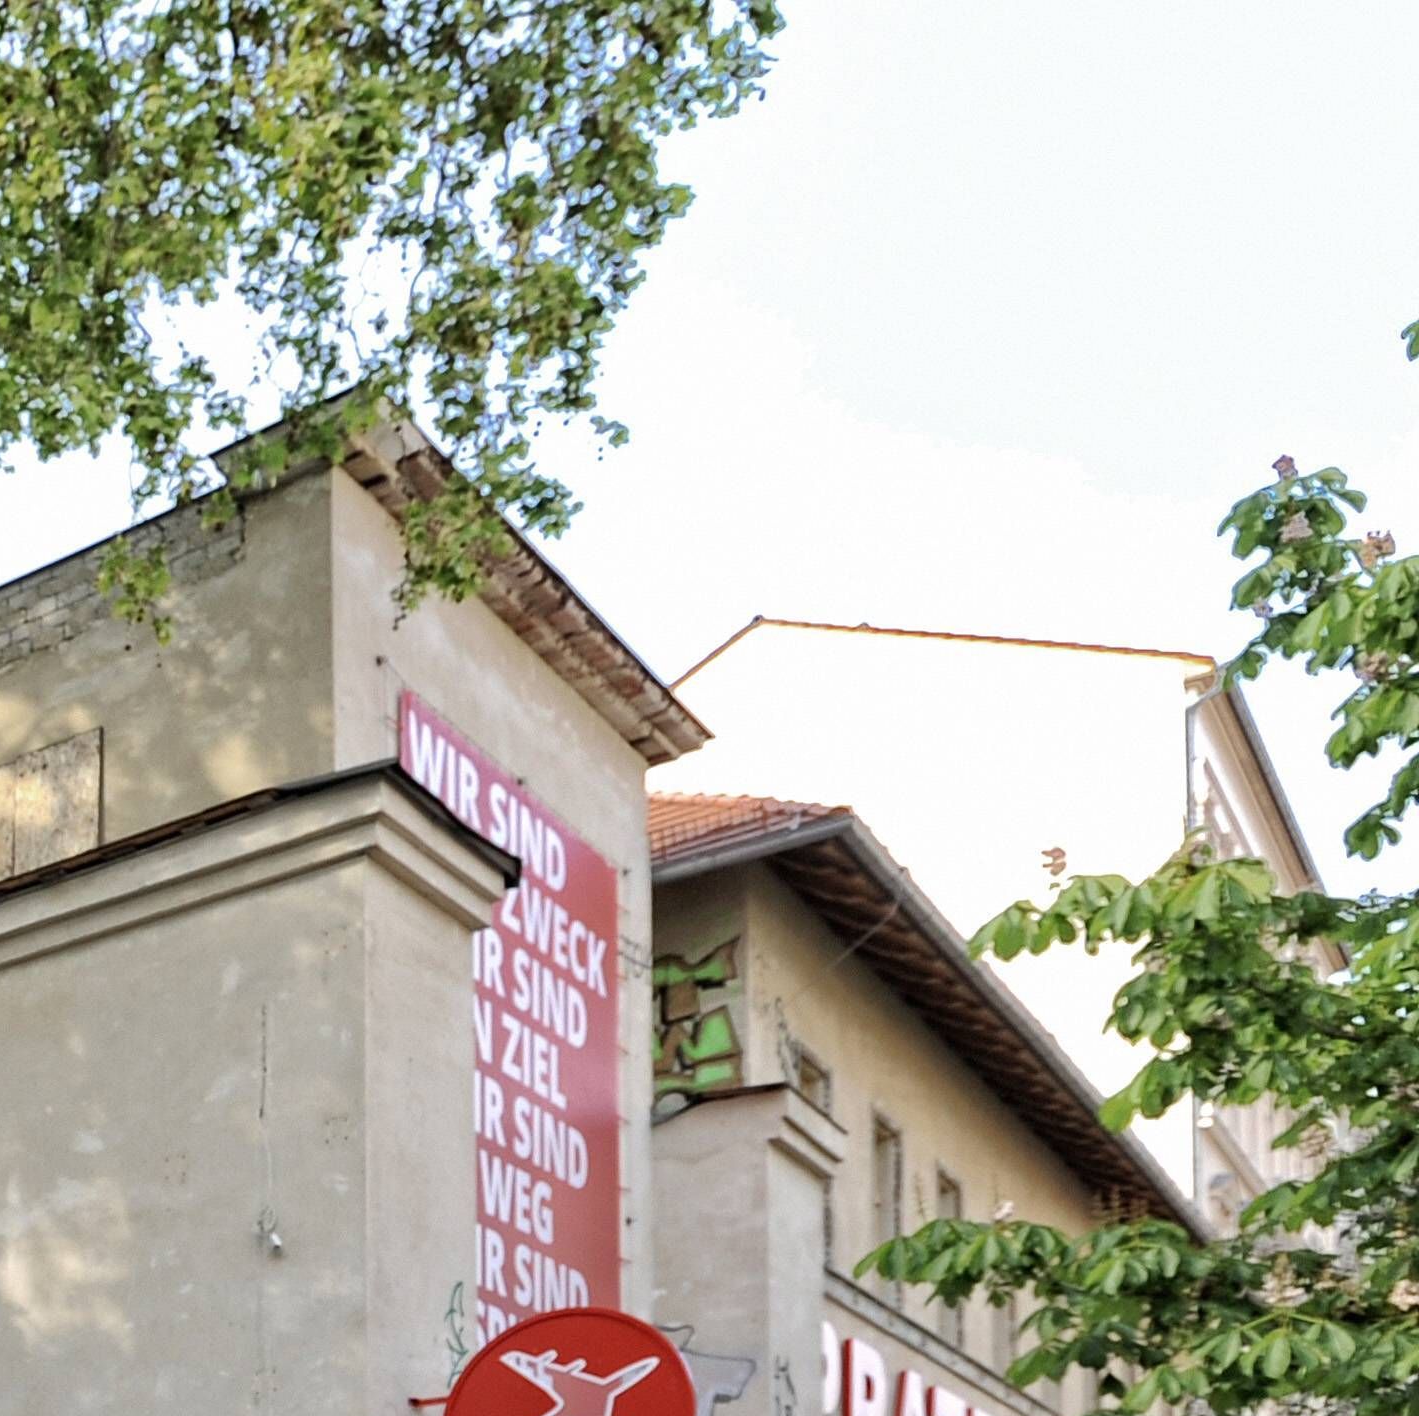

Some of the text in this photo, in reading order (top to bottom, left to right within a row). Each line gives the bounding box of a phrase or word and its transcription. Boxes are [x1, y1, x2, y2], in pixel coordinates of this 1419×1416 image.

[408, 709, 567, 892] WIR SIND
[472, 927, 506, 998] IR
[514, 948, 588, 1048] SIND
[501, 1012, 567, 1110] ZIEL
[473, 1069, 588, 1189] IR SIND
[480, 1149, 554, 1244] WEG
[475, 1224, 589, 1313] IR SIND
